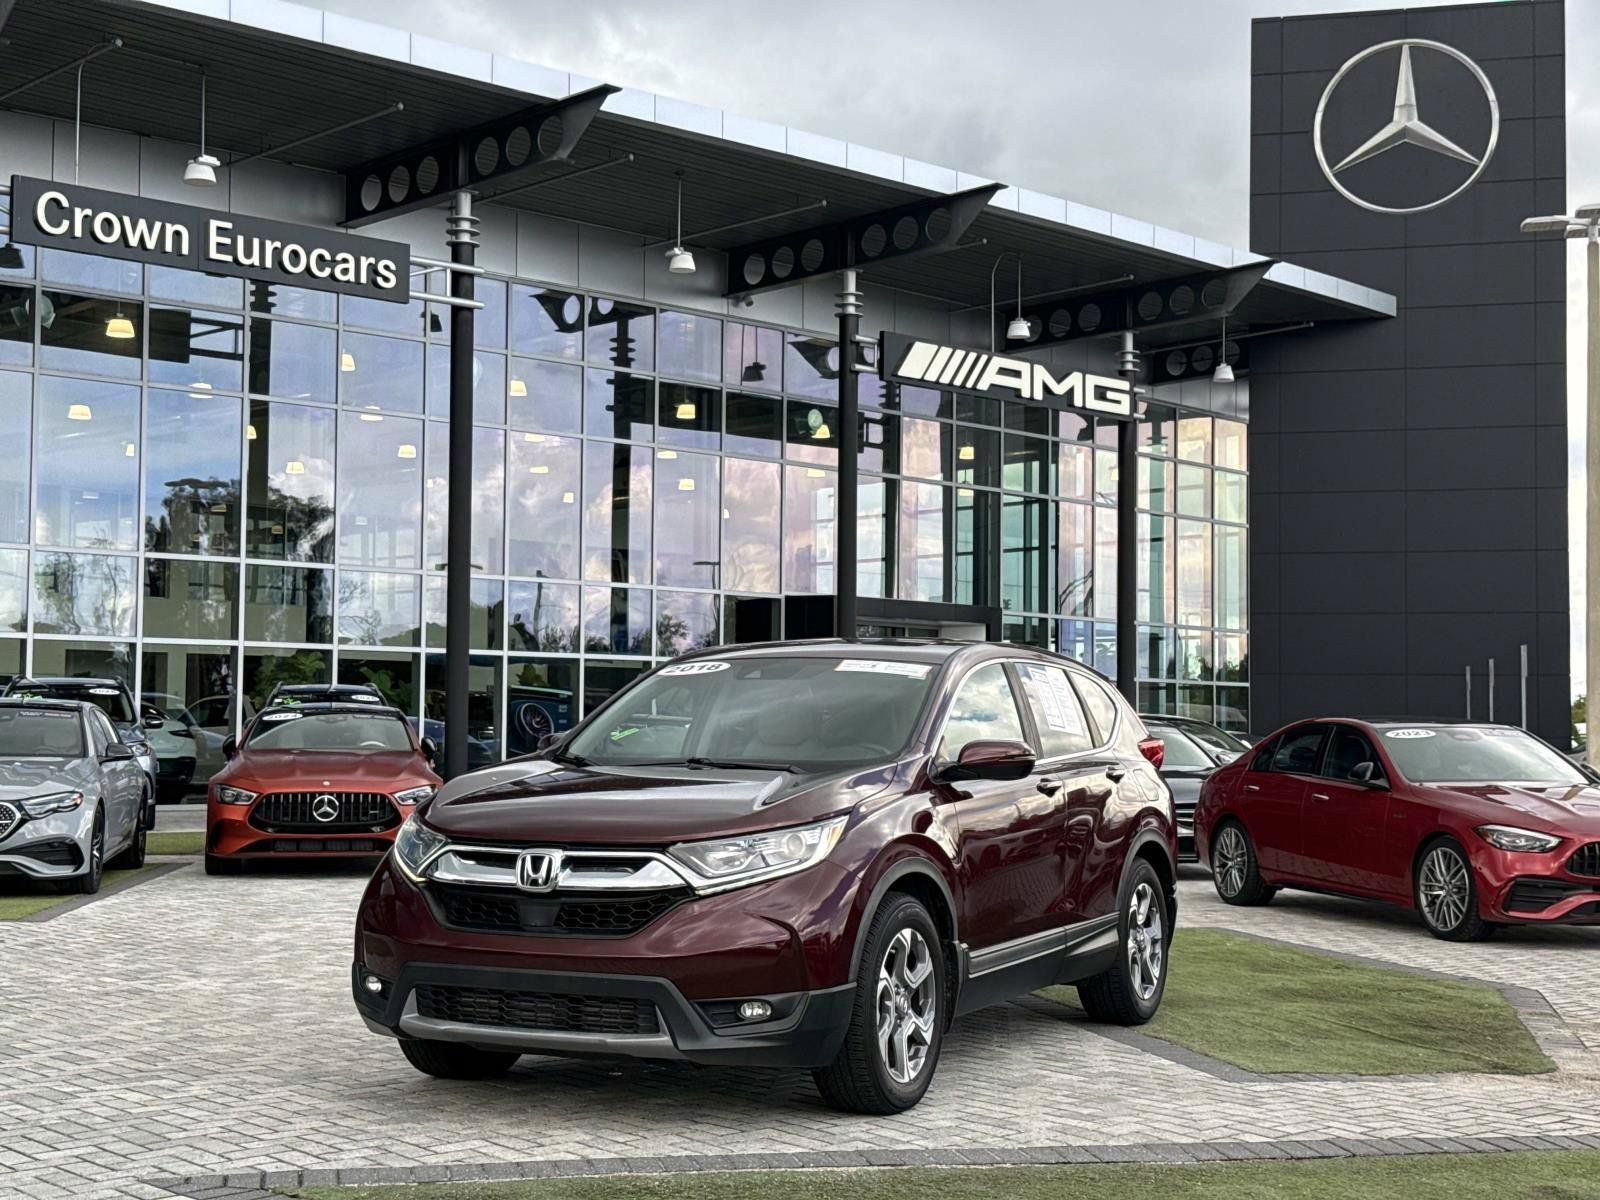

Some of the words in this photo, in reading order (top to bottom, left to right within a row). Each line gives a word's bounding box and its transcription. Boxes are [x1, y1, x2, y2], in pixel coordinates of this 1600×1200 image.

[35, 190, 190, 256] Crown
[208, 218, 398, 290] Eurocars
[975, 355, 1131, 416] AMG
[663, 663, 723, 674] 2018
